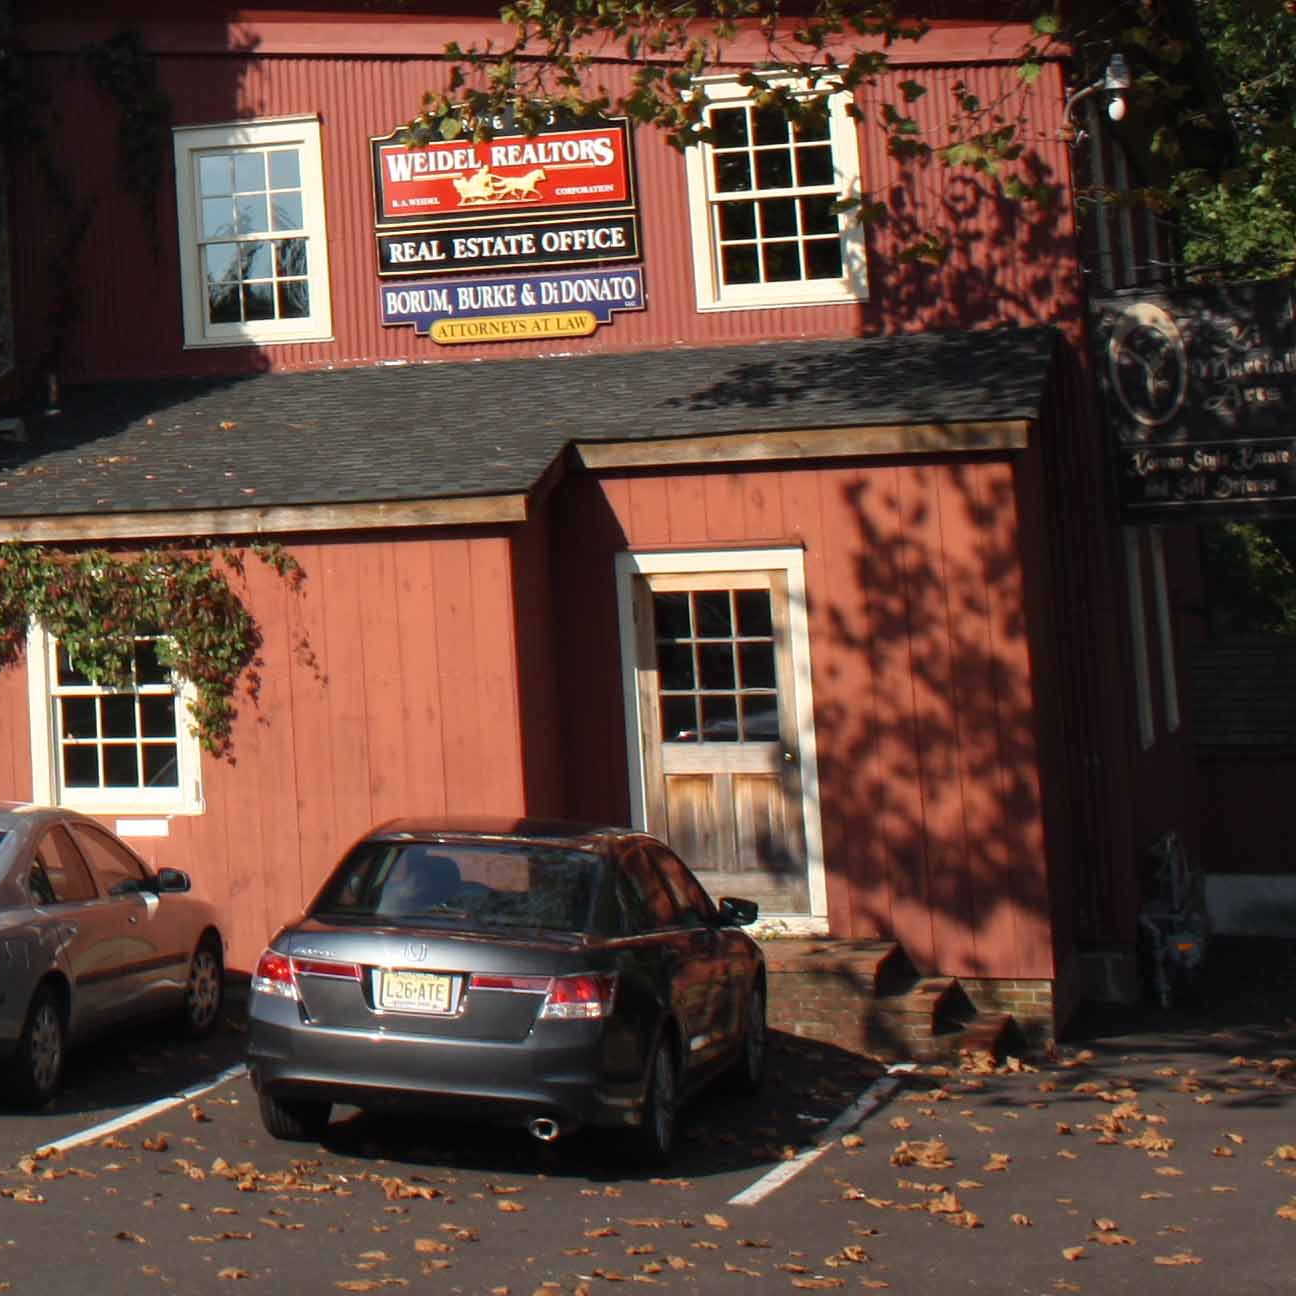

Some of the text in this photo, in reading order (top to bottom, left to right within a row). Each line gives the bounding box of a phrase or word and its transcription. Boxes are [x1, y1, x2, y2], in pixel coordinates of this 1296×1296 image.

[386, 138, 614, 182] WEIDEL REALTORS
[555, 184, 614, 195] CORPORATION
[389, 227, 626, 263] REAL ESTATE OFFICE
[386, 289, 452, 315] BORUM,
[457, 284, 516, 310] BURKE
[520, 283, 536, 306] &
[437, 316, 588, 339] ATTORNEYS AT LAW
